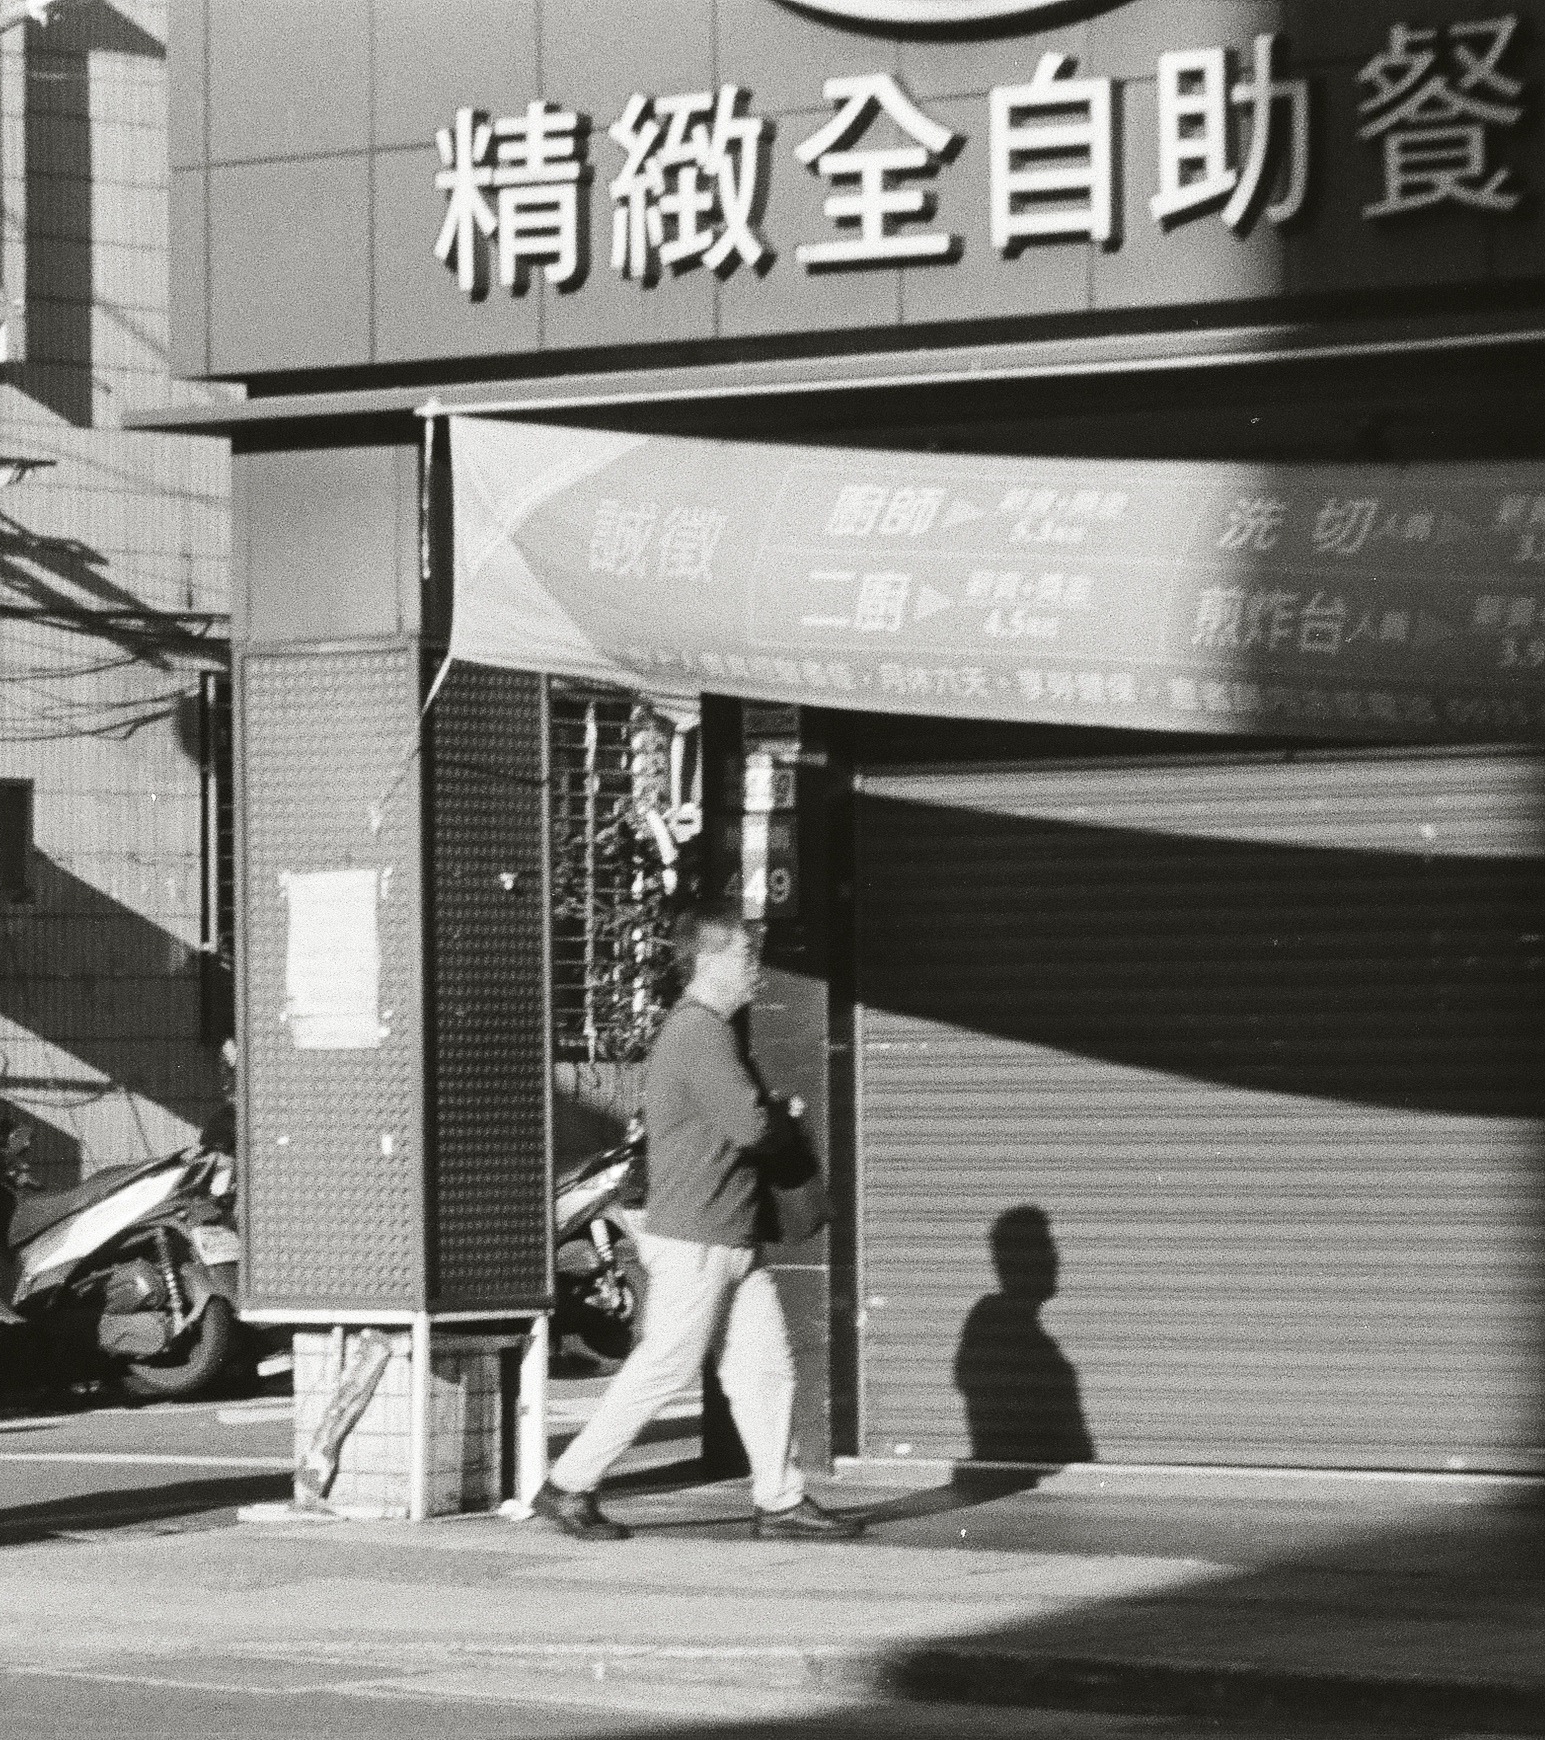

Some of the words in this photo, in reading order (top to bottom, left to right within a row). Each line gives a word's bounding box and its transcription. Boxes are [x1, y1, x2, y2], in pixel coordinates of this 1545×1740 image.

[433, 13, 1525, 291] 精緻全自助餐
[587, 498, 728, 582] 誠徵
[825, 483, 946, 538] 廚師
[801, 569, 912, 633] 二廚
